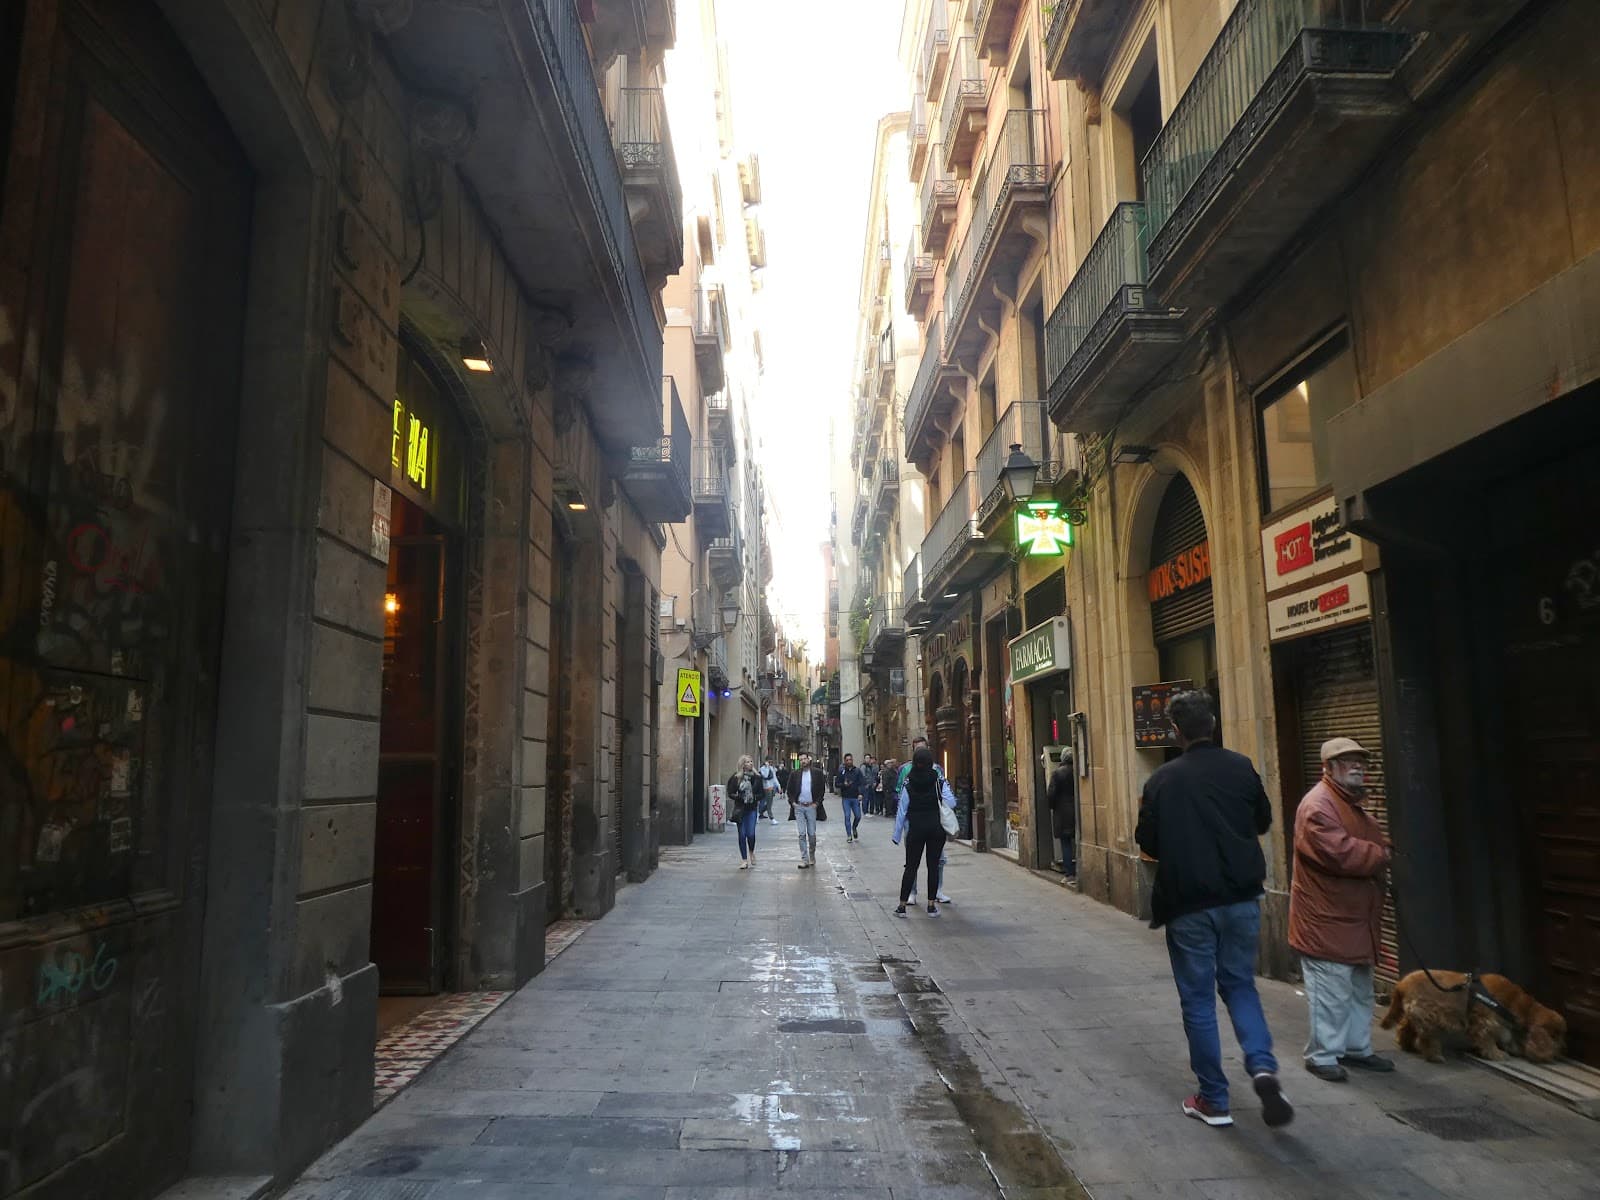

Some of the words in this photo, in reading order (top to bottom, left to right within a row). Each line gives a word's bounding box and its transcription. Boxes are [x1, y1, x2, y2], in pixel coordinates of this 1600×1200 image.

[1176, 540, 1211, 590] SUSH
[1287, 599, 1309, 618] HOUSE
[1310, 597, 1319, 612] OF
[1014, 633, 1053, 672] FARMÀCIA
